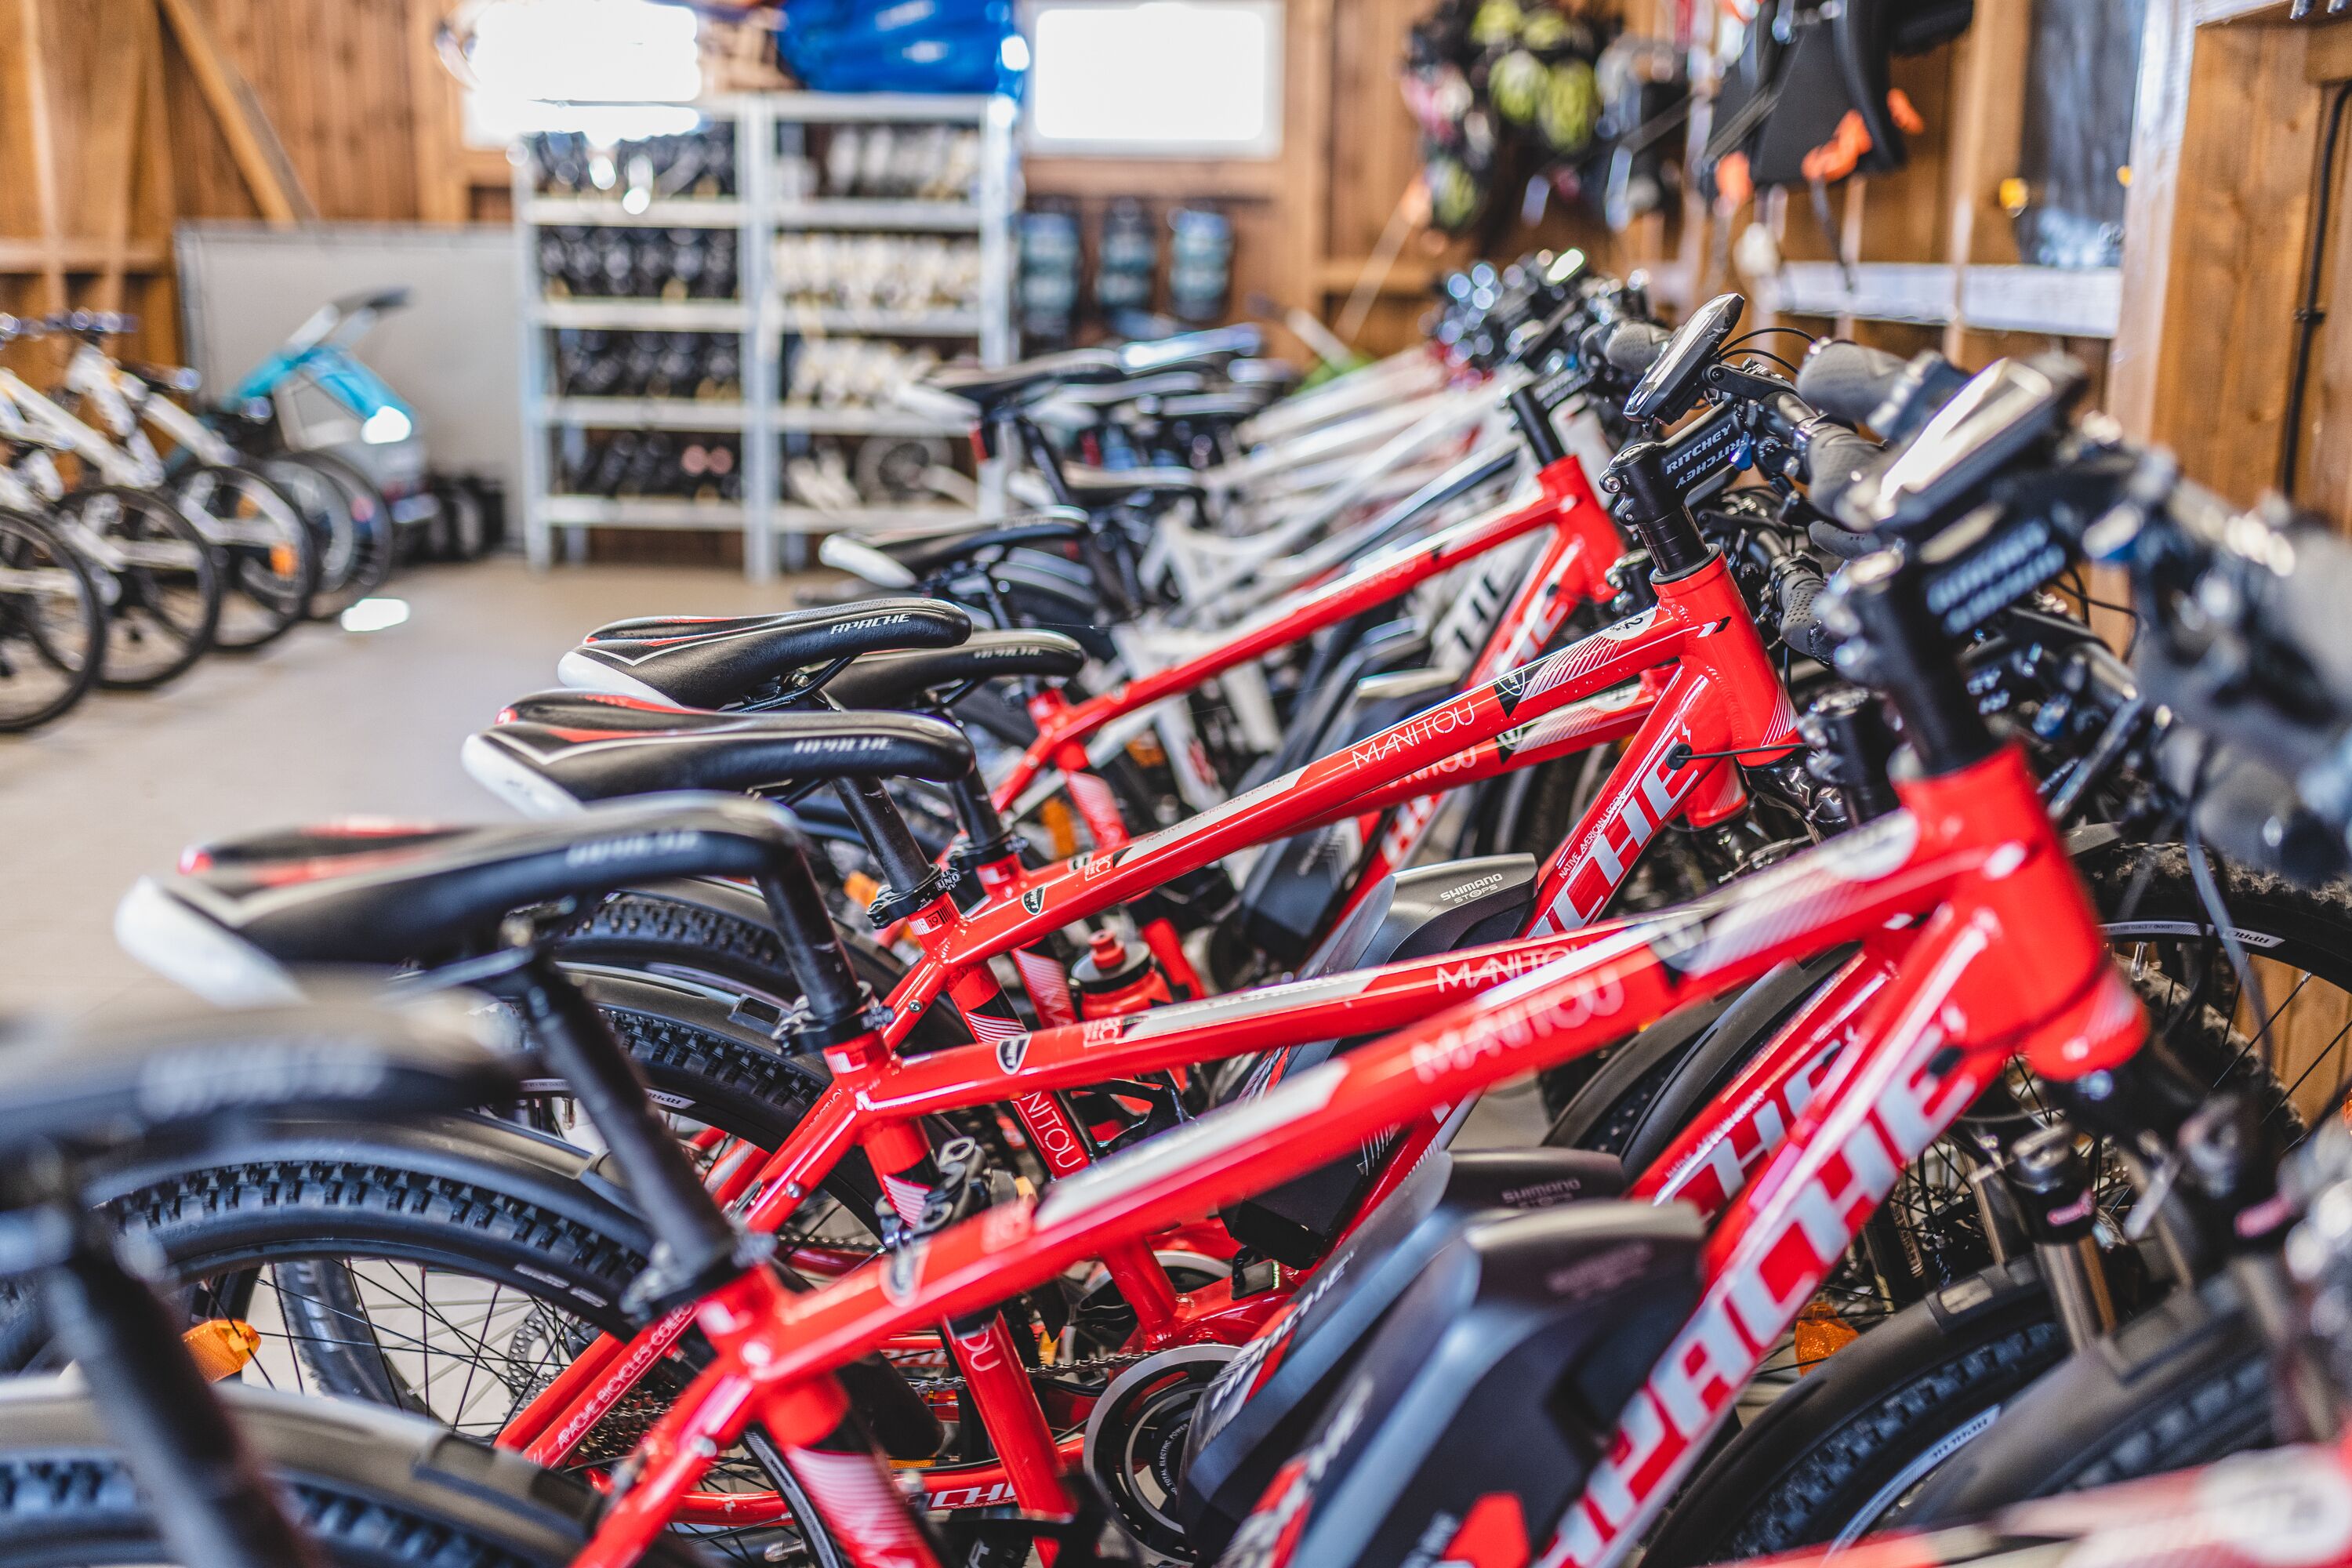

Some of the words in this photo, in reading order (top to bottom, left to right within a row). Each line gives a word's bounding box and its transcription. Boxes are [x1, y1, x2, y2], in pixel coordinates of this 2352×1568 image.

[1666, 423, 1731, 475] RITCHEY
[830, 612, 912, 635] APACHE
[1352, 701, 1475, 770] MANITOU
[1559, 851, 1582, 879] NATIVE
[1440, 873, 1503, 901] SHIMANO
[557, 1399, 599, 1450] APACHE
[597, 1345, 653, 1403] BICYCLES
[1159, 1439, 1172, 1467] ELECTRIC
[1160, 1468, 1173, 1487] TOTAL
